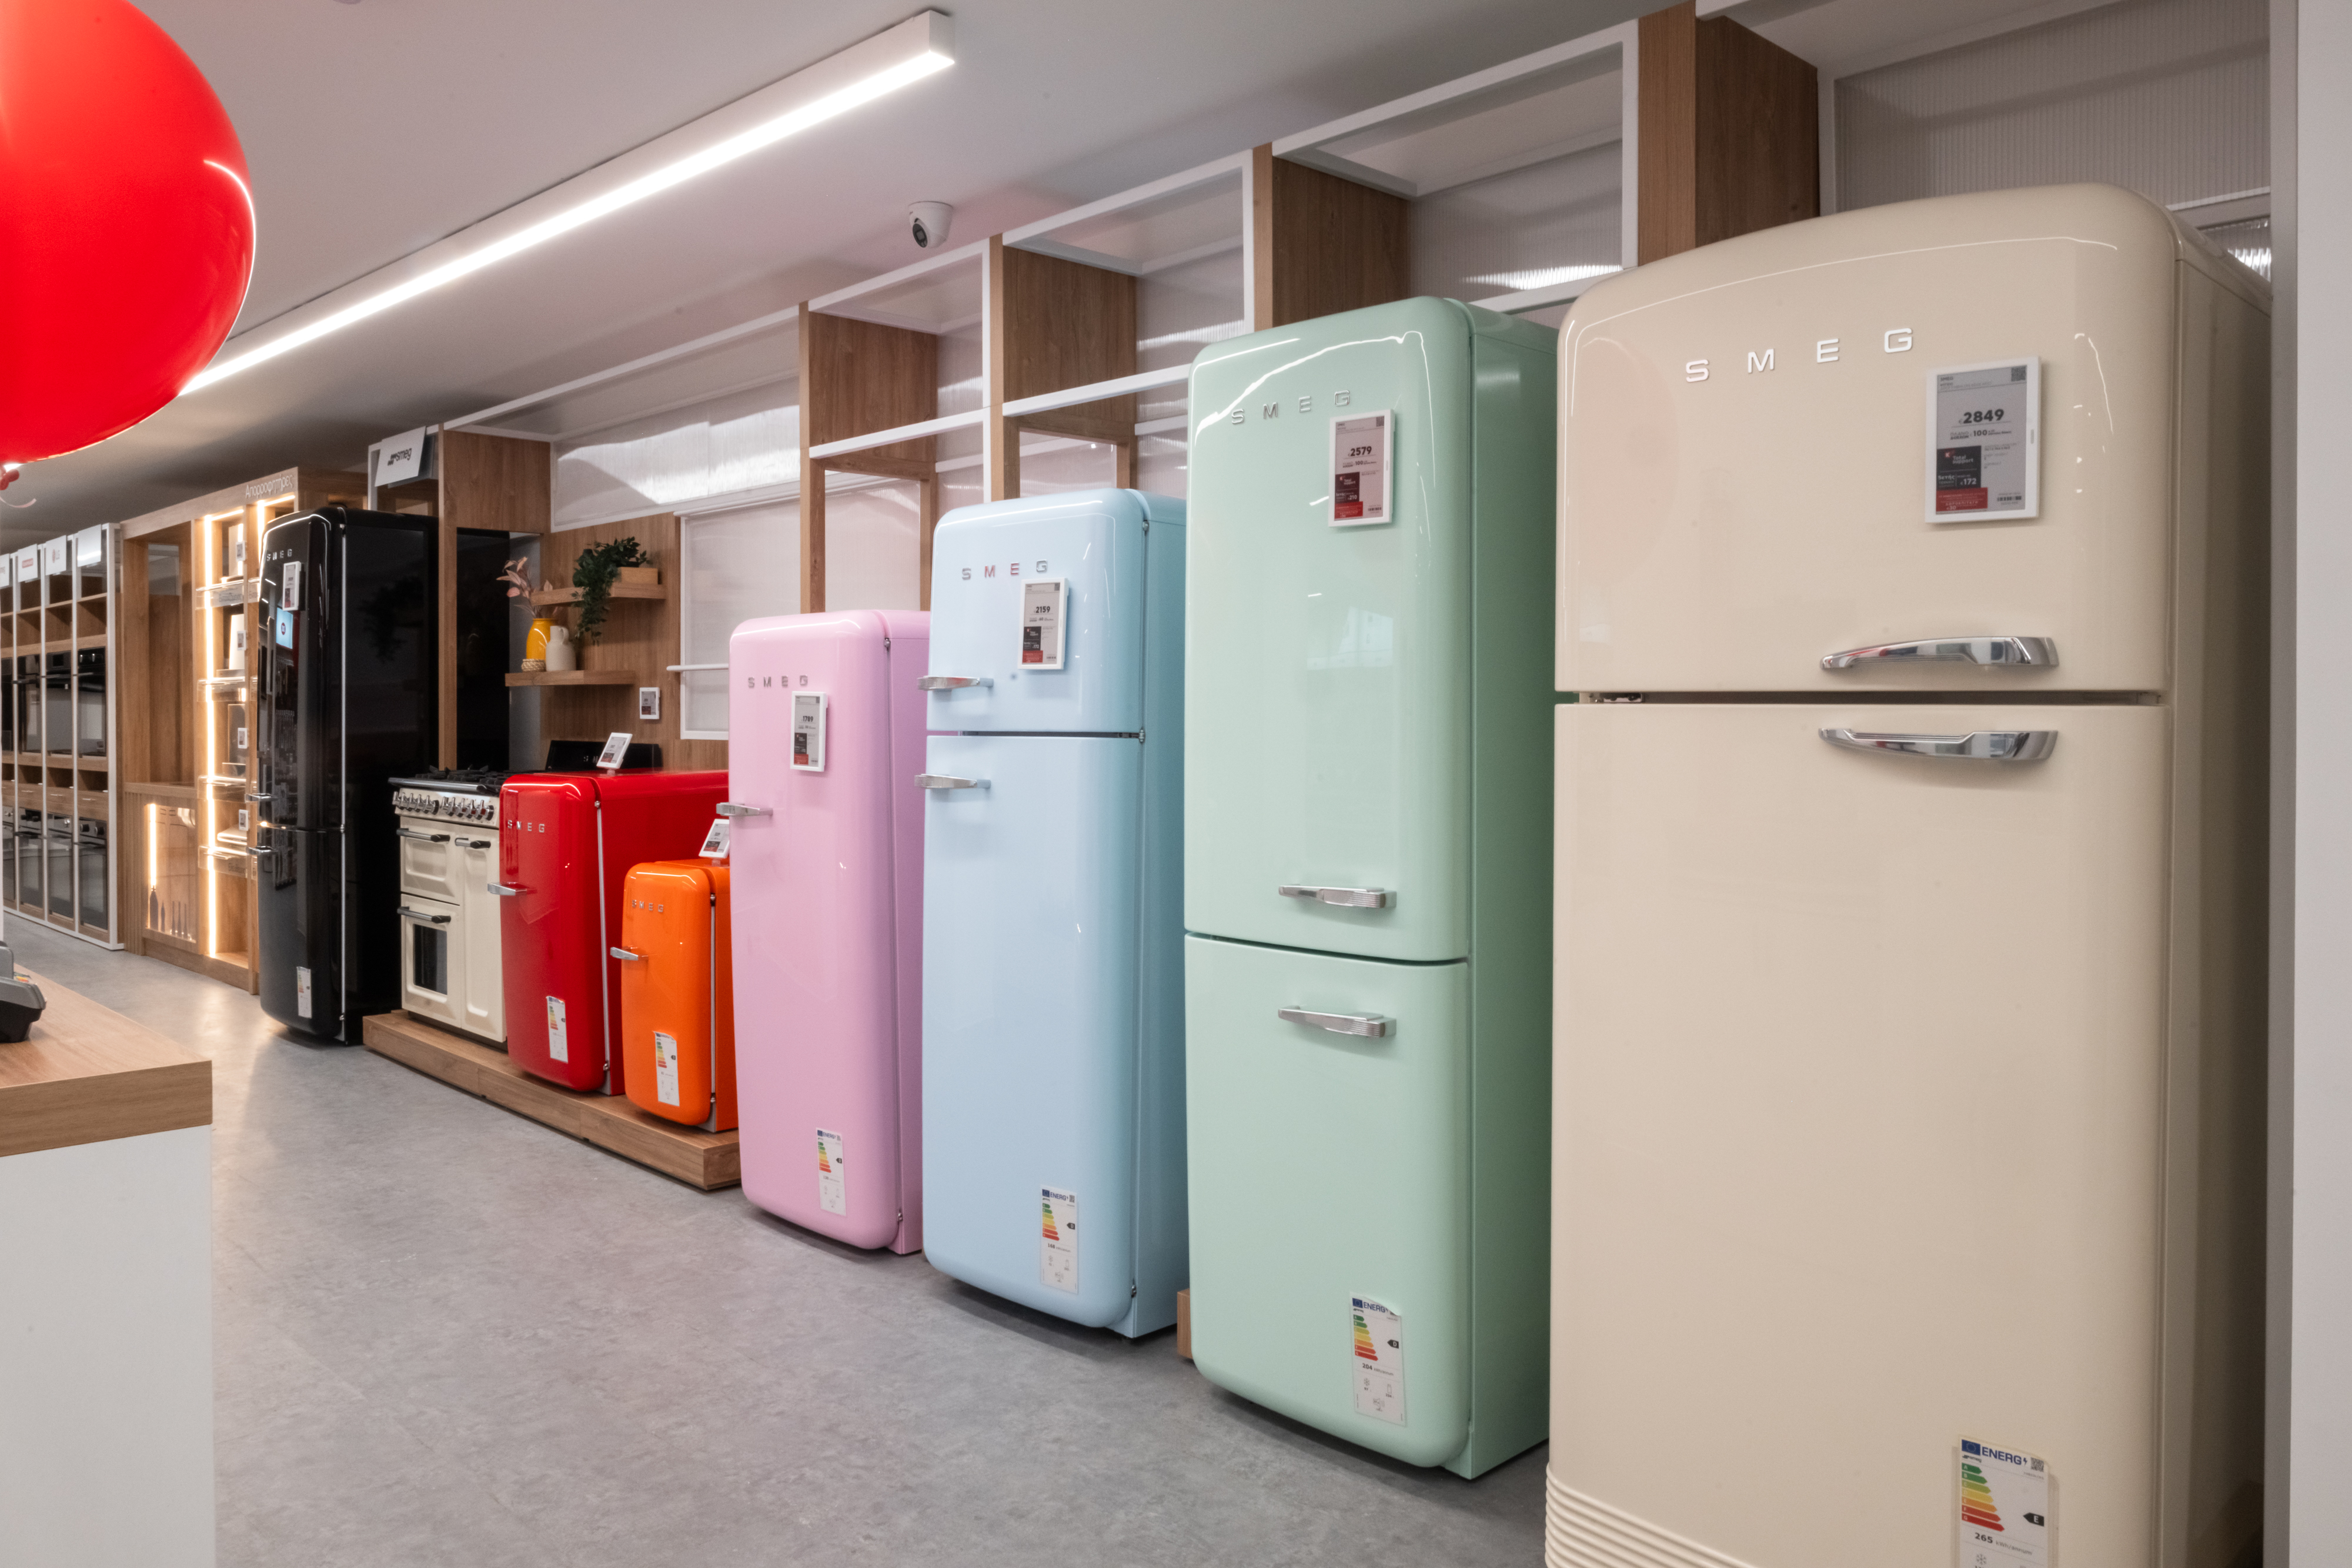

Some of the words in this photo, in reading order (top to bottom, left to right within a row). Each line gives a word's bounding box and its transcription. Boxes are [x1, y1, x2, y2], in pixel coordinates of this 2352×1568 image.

[1685, 327, 1913, 383] SMEG
[1231, 389, 1350, 425] SMEG
[396, 448, 412, 462] smeg
[961, 559, 1048, 581] SMEG
[747, 674, 808, 688] SMEG
[507, 820, 545, 834] SMEG
[632, 900, 664, 913] SMEG
[1362, 1363, 1373, 1371] 204
[1975, 1532, 1993, 1544] 265
[1996, 1540, 2033, 1556] kWh/annum
